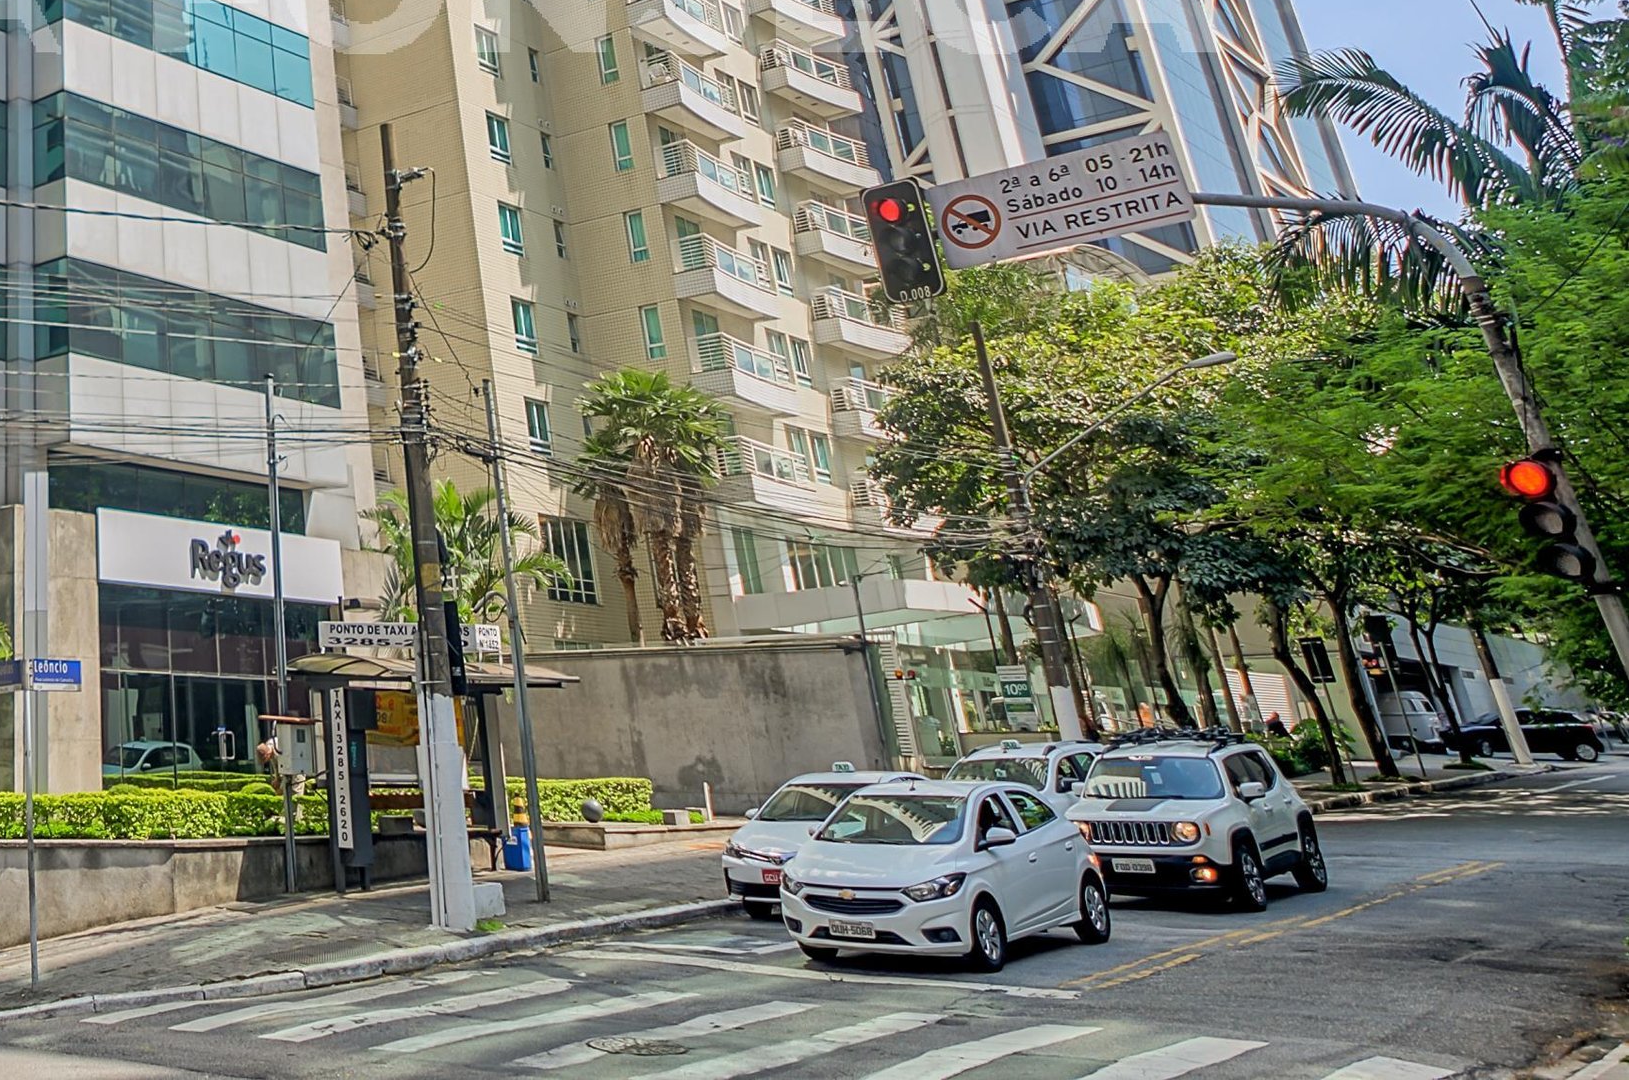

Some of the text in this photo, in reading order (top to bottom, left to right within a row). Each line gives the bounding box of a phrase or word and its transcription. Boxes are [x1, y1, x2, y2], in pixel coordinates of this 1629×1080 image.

[1007, 185, 1083, 213] Sábado
[1096, 176, 1117, 193] 10
[1139, 163, 1176, 184] 14h
[1029, 175, 1041, 187] a
[1085, 154, 1113, 173] 05
[1129, 142, 1169, 164] 21h
[1015, 191, 1183, 240] VIA RESTRITA
[190, 537, 267, 589] Regus
[329, 624, 364, 635] PONTO
[367, 625, 381, 635] DE
[383, 625, 408, 636] TAXI
